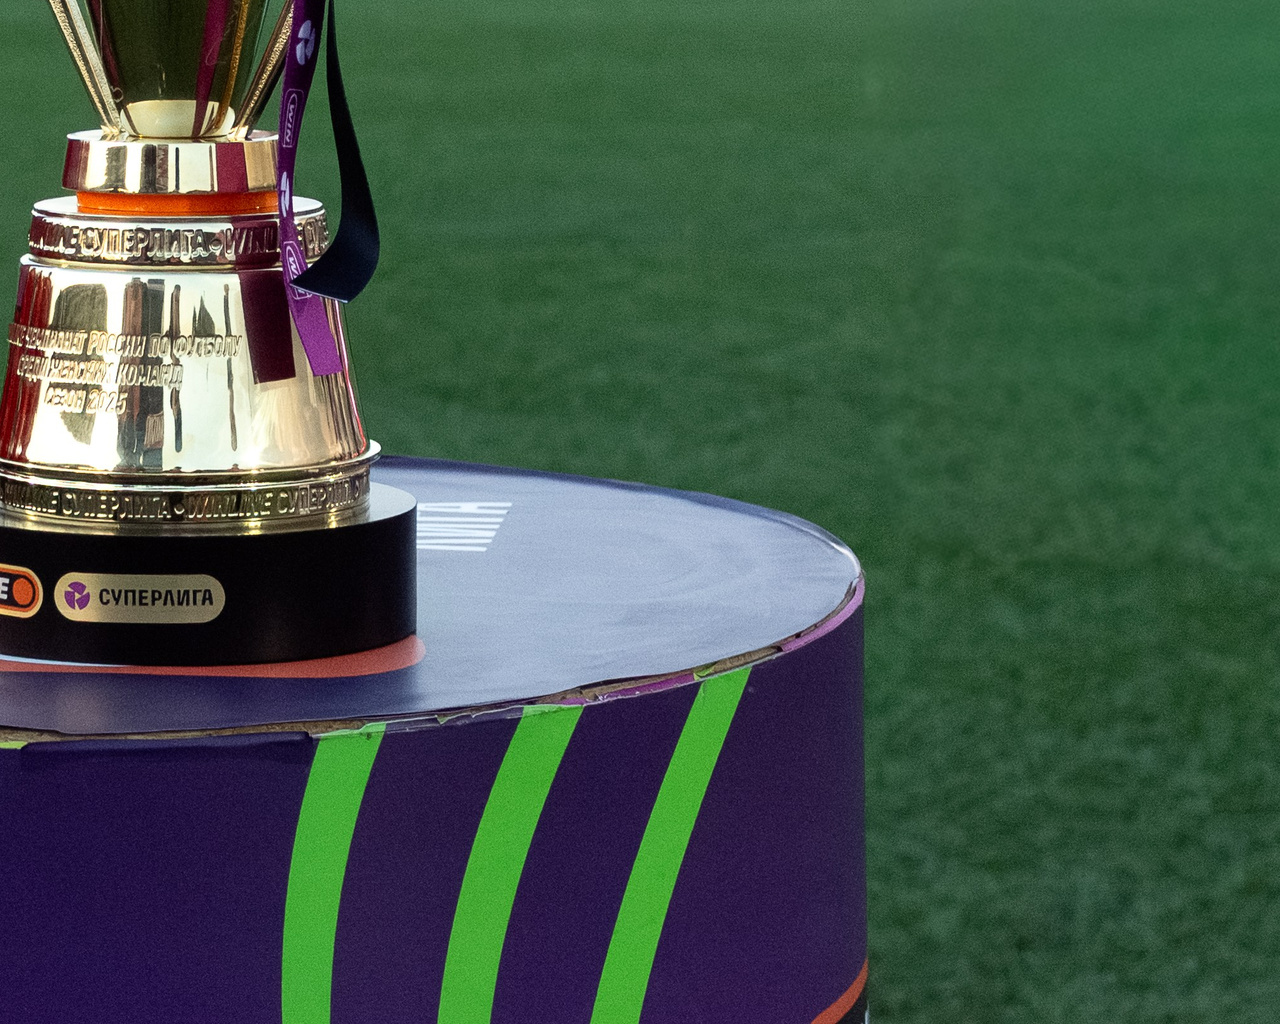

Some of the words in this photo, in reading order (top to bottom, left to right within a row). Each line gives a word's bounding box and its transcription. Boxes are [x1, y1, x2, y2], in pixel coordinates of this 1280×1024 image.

[80, 226, 208, 258] СУПЕРЛИГА
[86, 388, 128, 416] 2025
[98, 588, 214, 607] СУПЕРЛИГА
